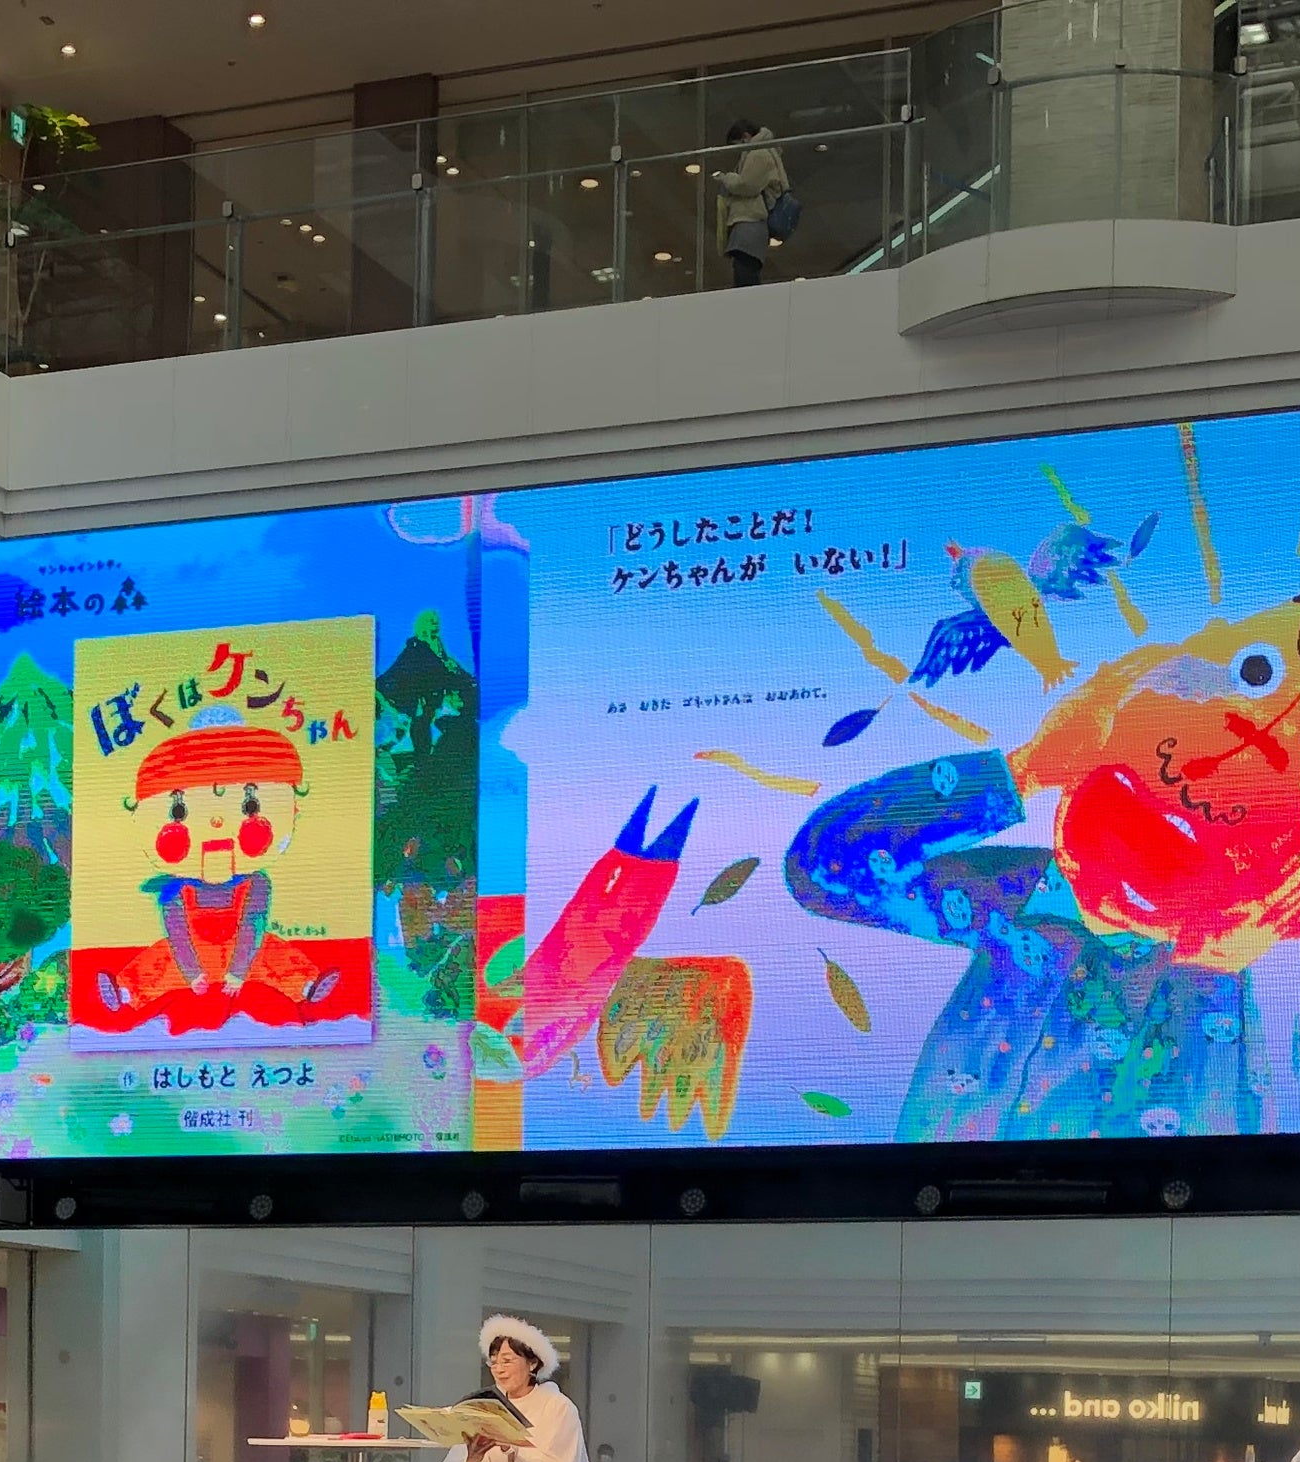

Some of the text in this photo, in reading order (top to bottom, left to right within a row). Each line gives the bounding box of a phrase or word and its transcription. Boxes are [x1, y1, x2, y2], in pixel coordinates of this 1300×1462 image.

[611, 553, 767, 594] ケンちゃんが
[90, 642, 358, 757] ぼくはケンちゃん
[153, 1066, 237, 1089] はしもと
[251, 1062, 316, 1088] えつよ
